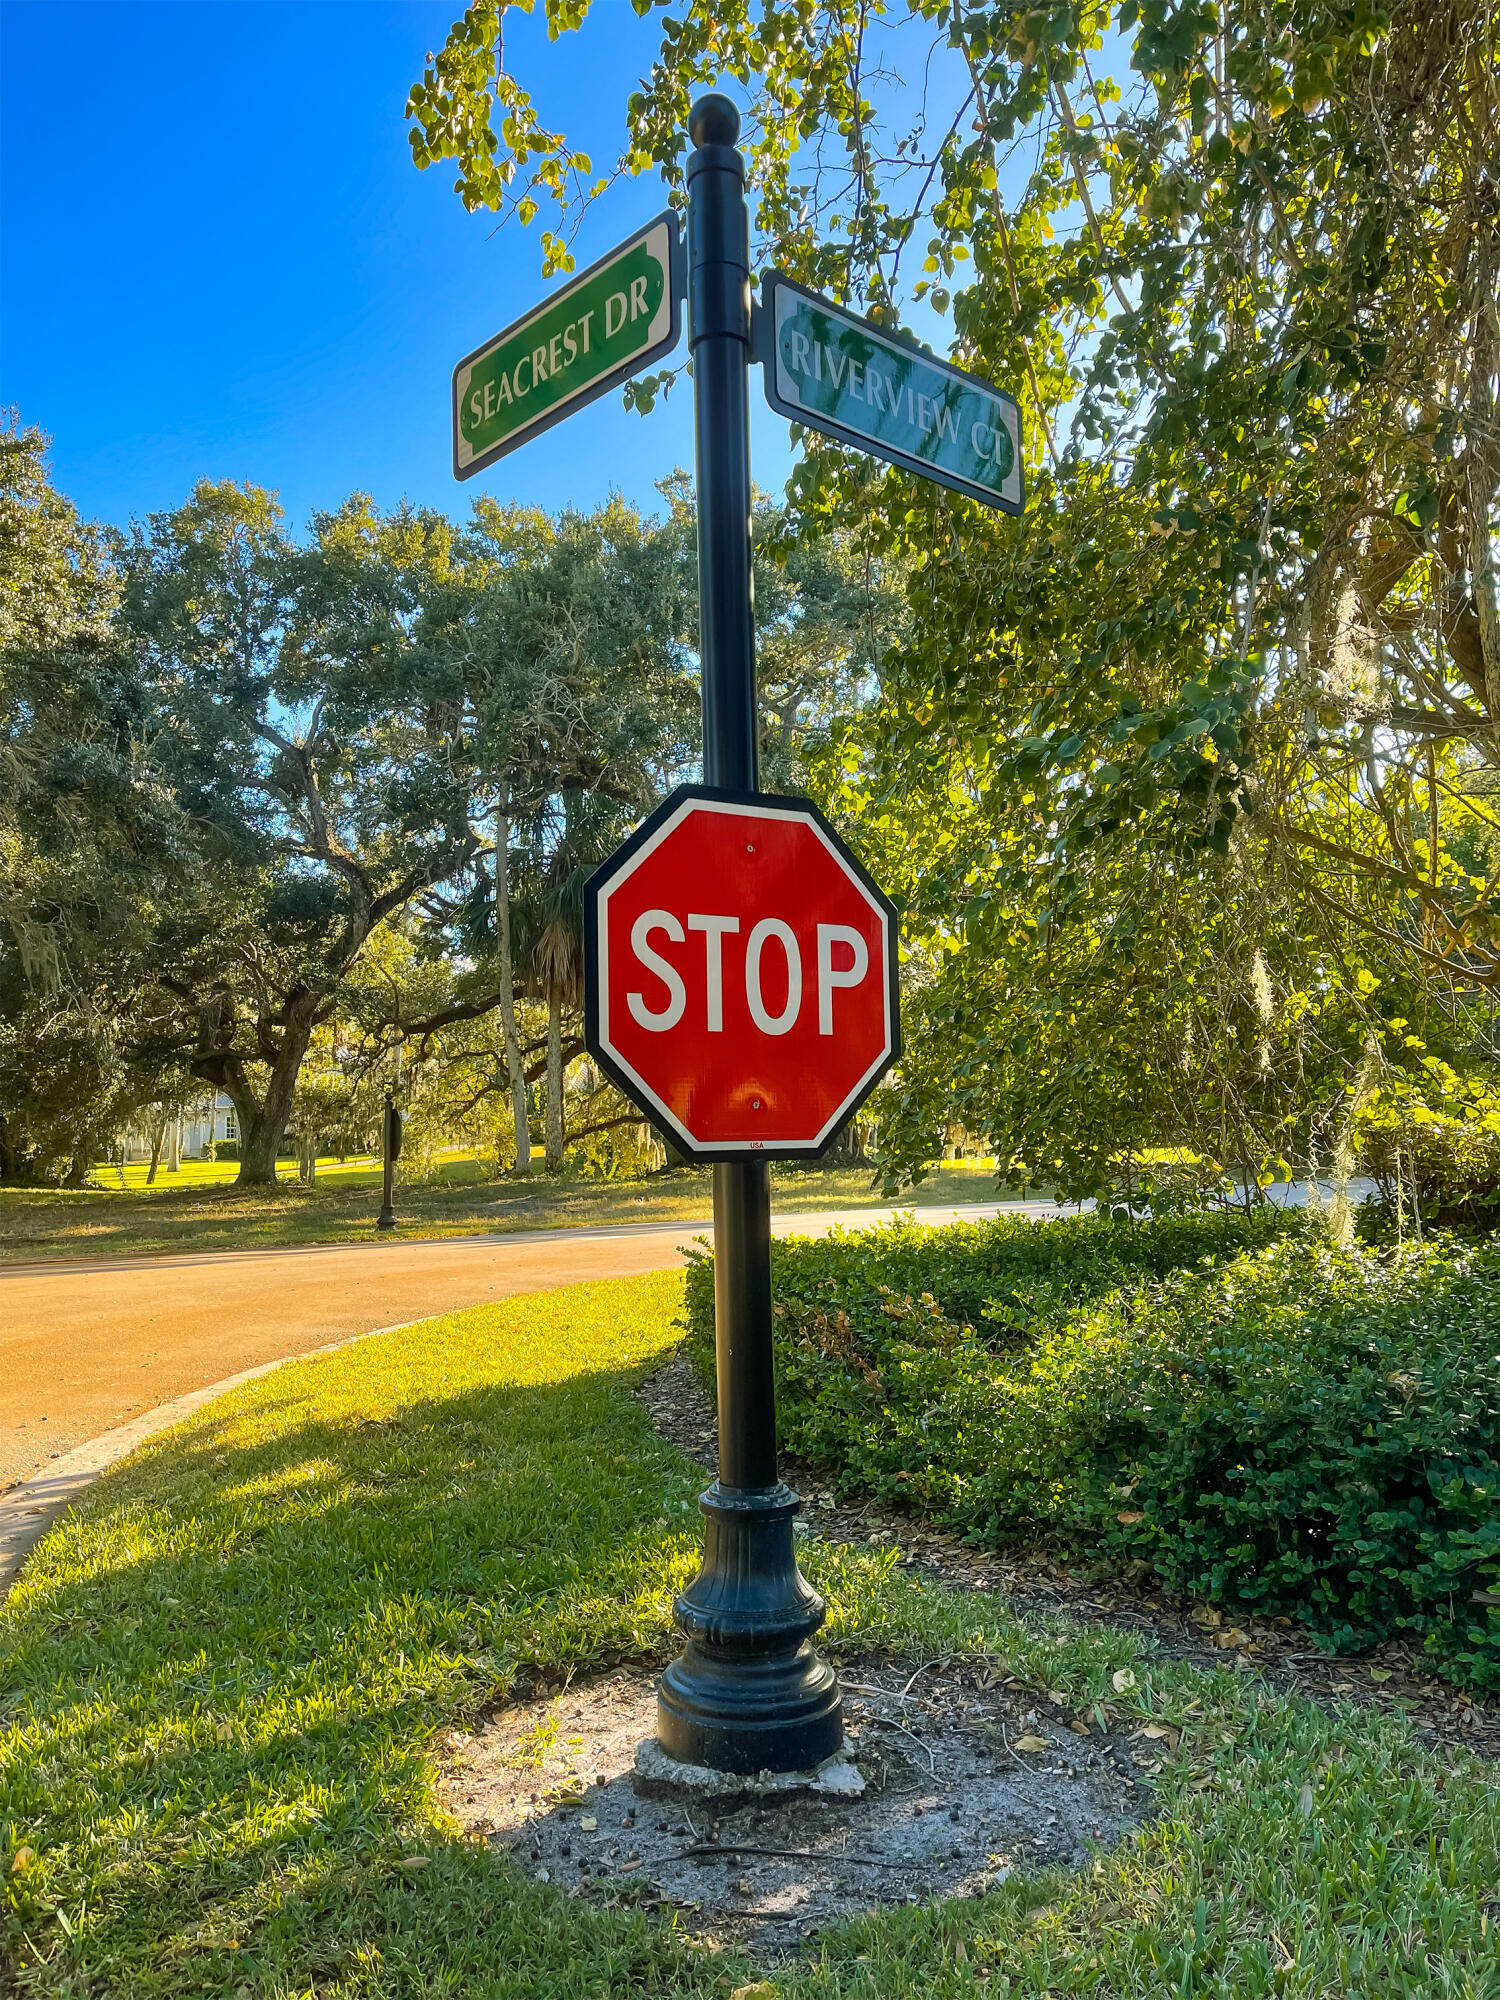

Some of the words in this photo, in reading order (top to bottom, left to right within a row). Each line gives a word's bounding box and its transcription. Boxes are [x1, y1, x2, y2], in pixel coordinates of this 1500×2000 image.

[470, 310, 595, 429] SEACREST
[605, 275, 650, 339] DR
[791, 330, 961, 444] RIVERVIEW
[971, 421, 1005, 465] CT
[626, 909, 869, 1036] STOP
